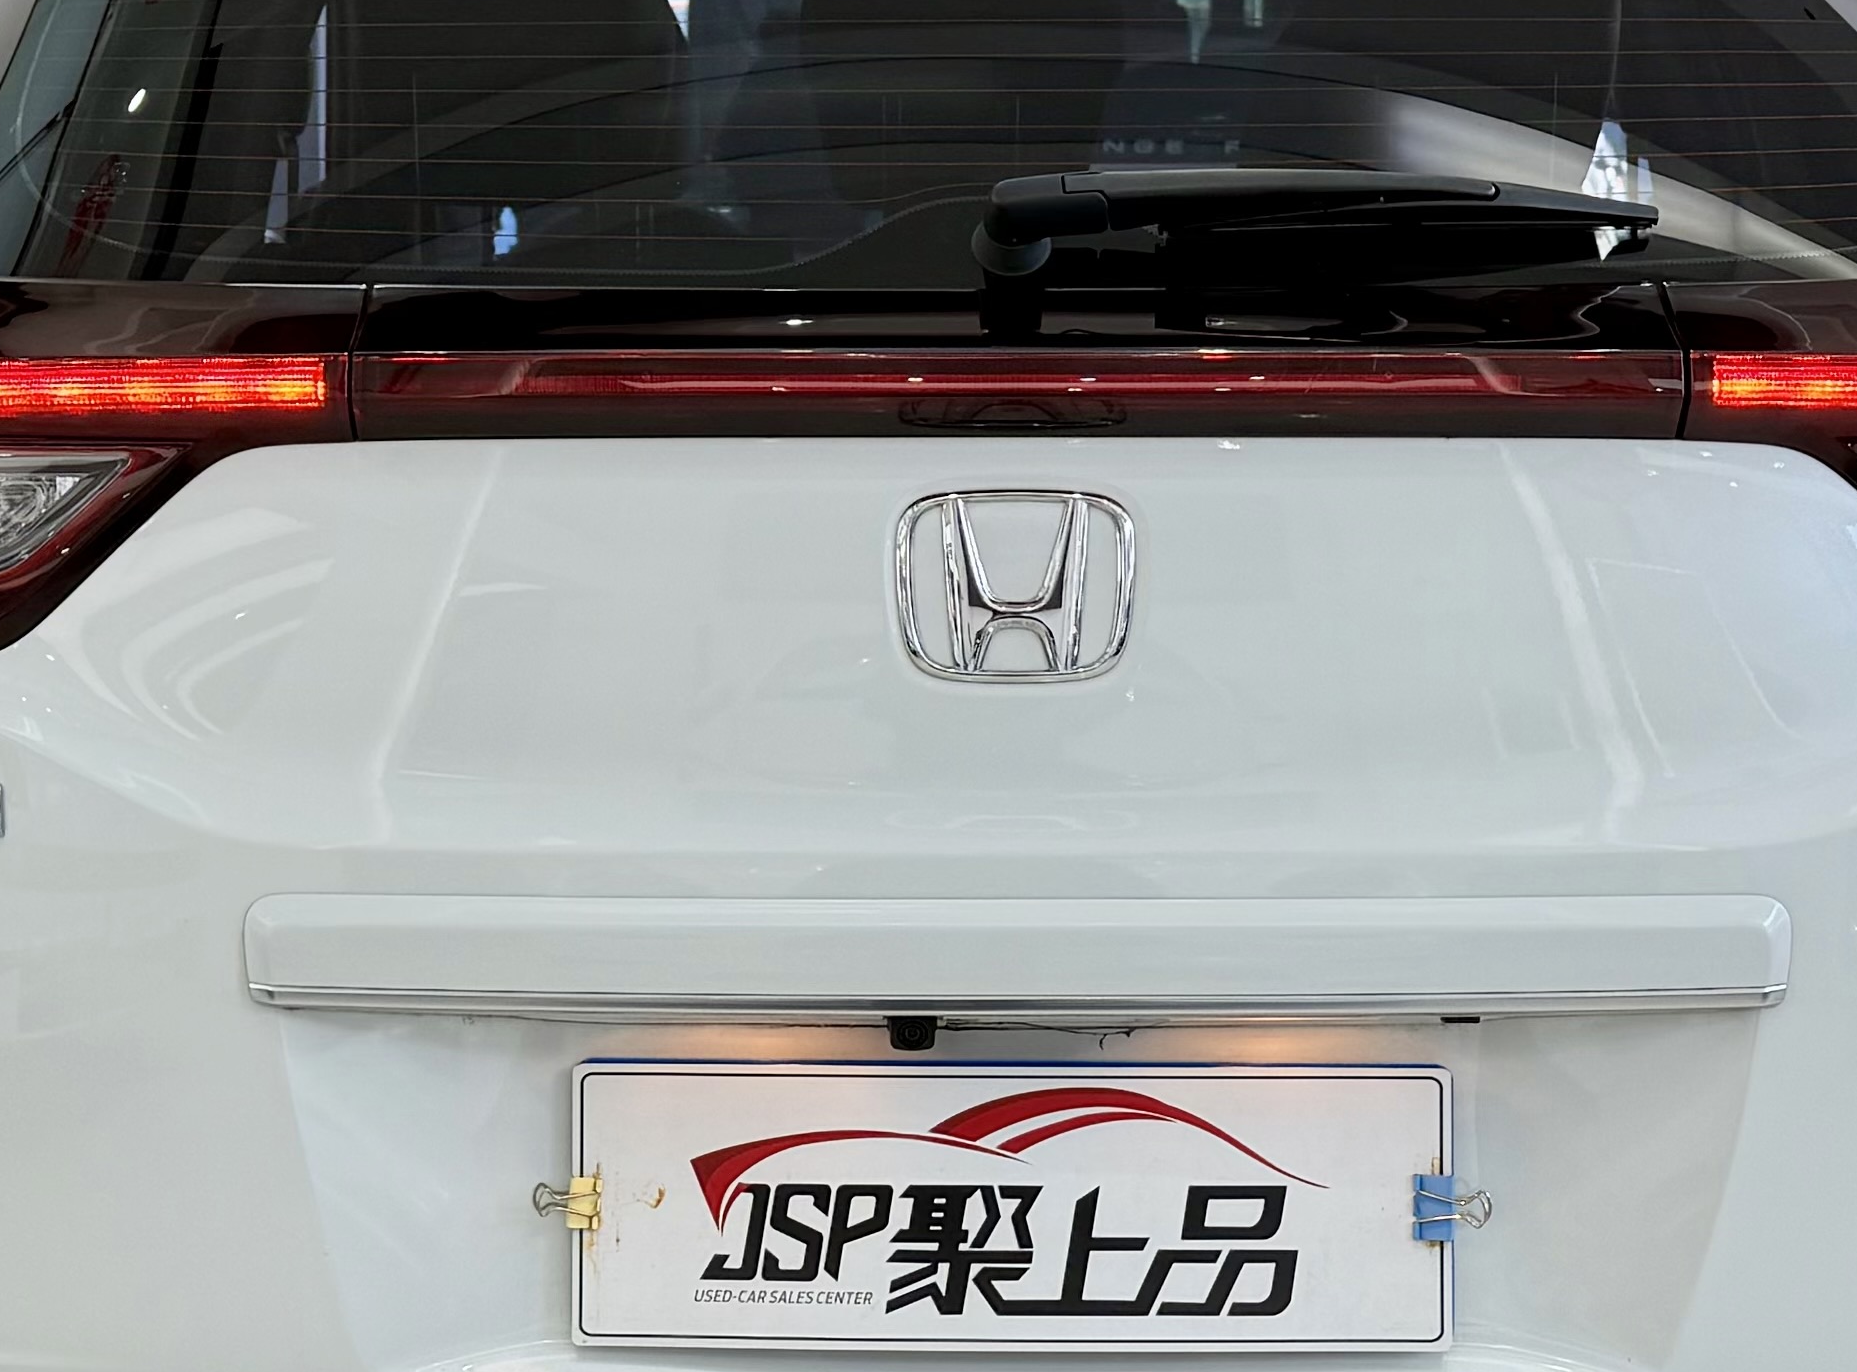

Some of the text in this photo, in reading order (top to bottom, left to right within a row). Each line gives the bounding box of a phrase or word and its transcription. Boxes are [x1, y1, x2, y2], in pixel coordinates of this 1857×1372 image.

[700, 1182, 1300, 1317] JSP 聚上品
[694, 1289, 874, 1306] USED-CAR SALES CENTER
